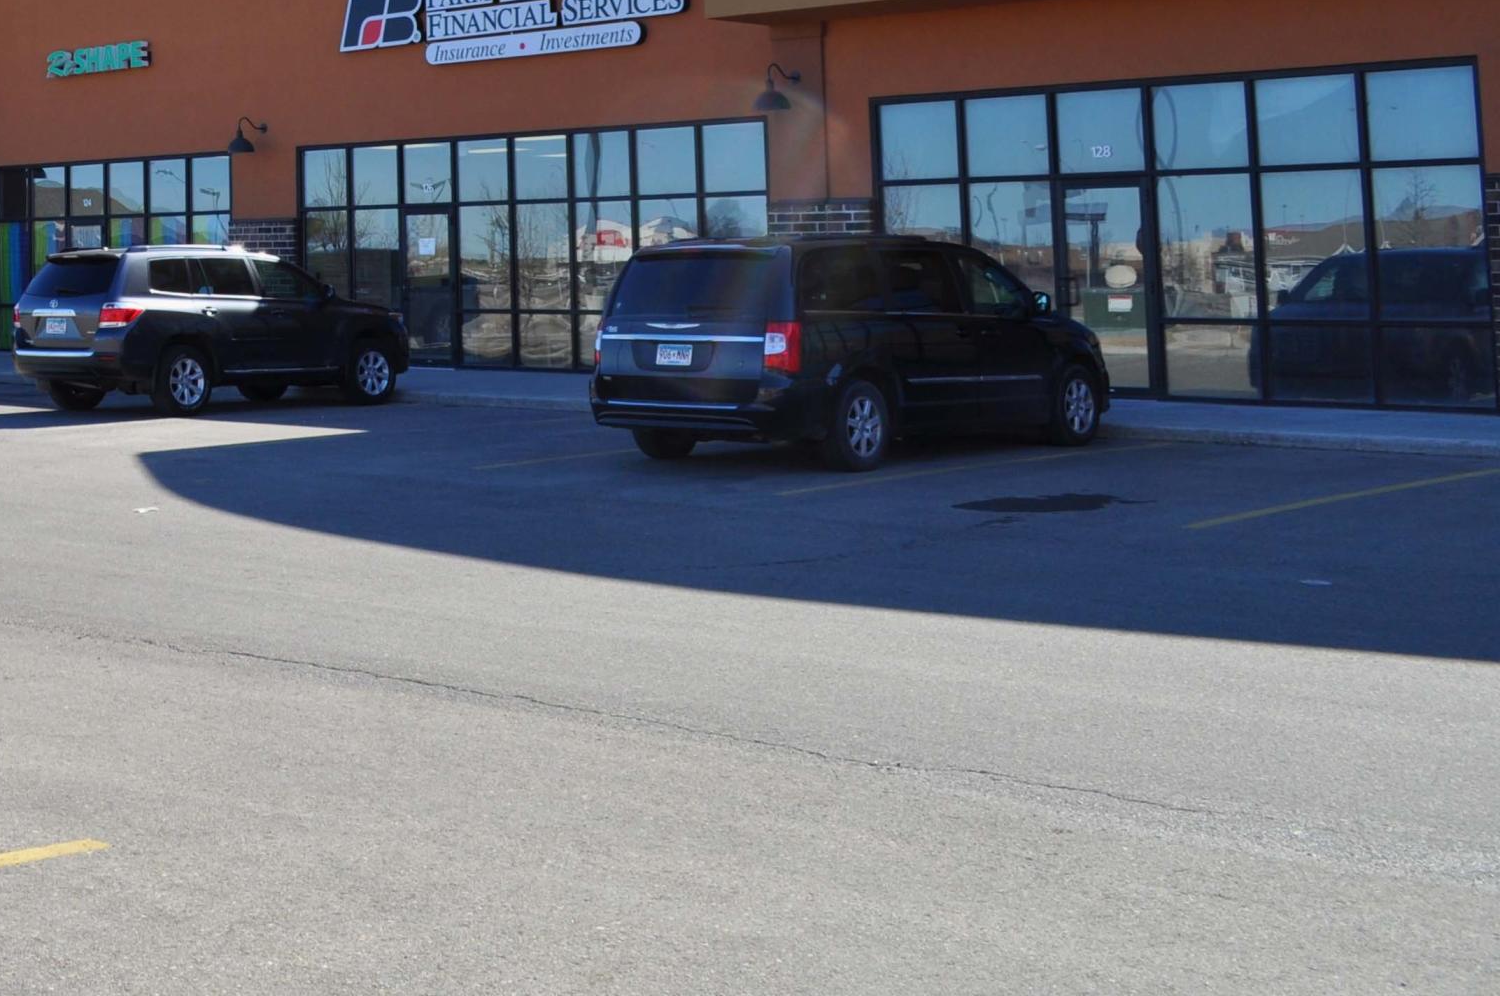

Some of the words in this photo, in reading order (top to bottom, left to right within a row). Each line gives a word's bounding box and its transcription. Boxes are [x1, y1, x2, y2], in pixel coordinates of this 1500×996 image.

[428, 3, 555, 38] FINANCIAL
[434, 43, 507, 62] Insurance
[540, 27, 634, 51] Investments
[1092, 145, 1111, 157] 128
